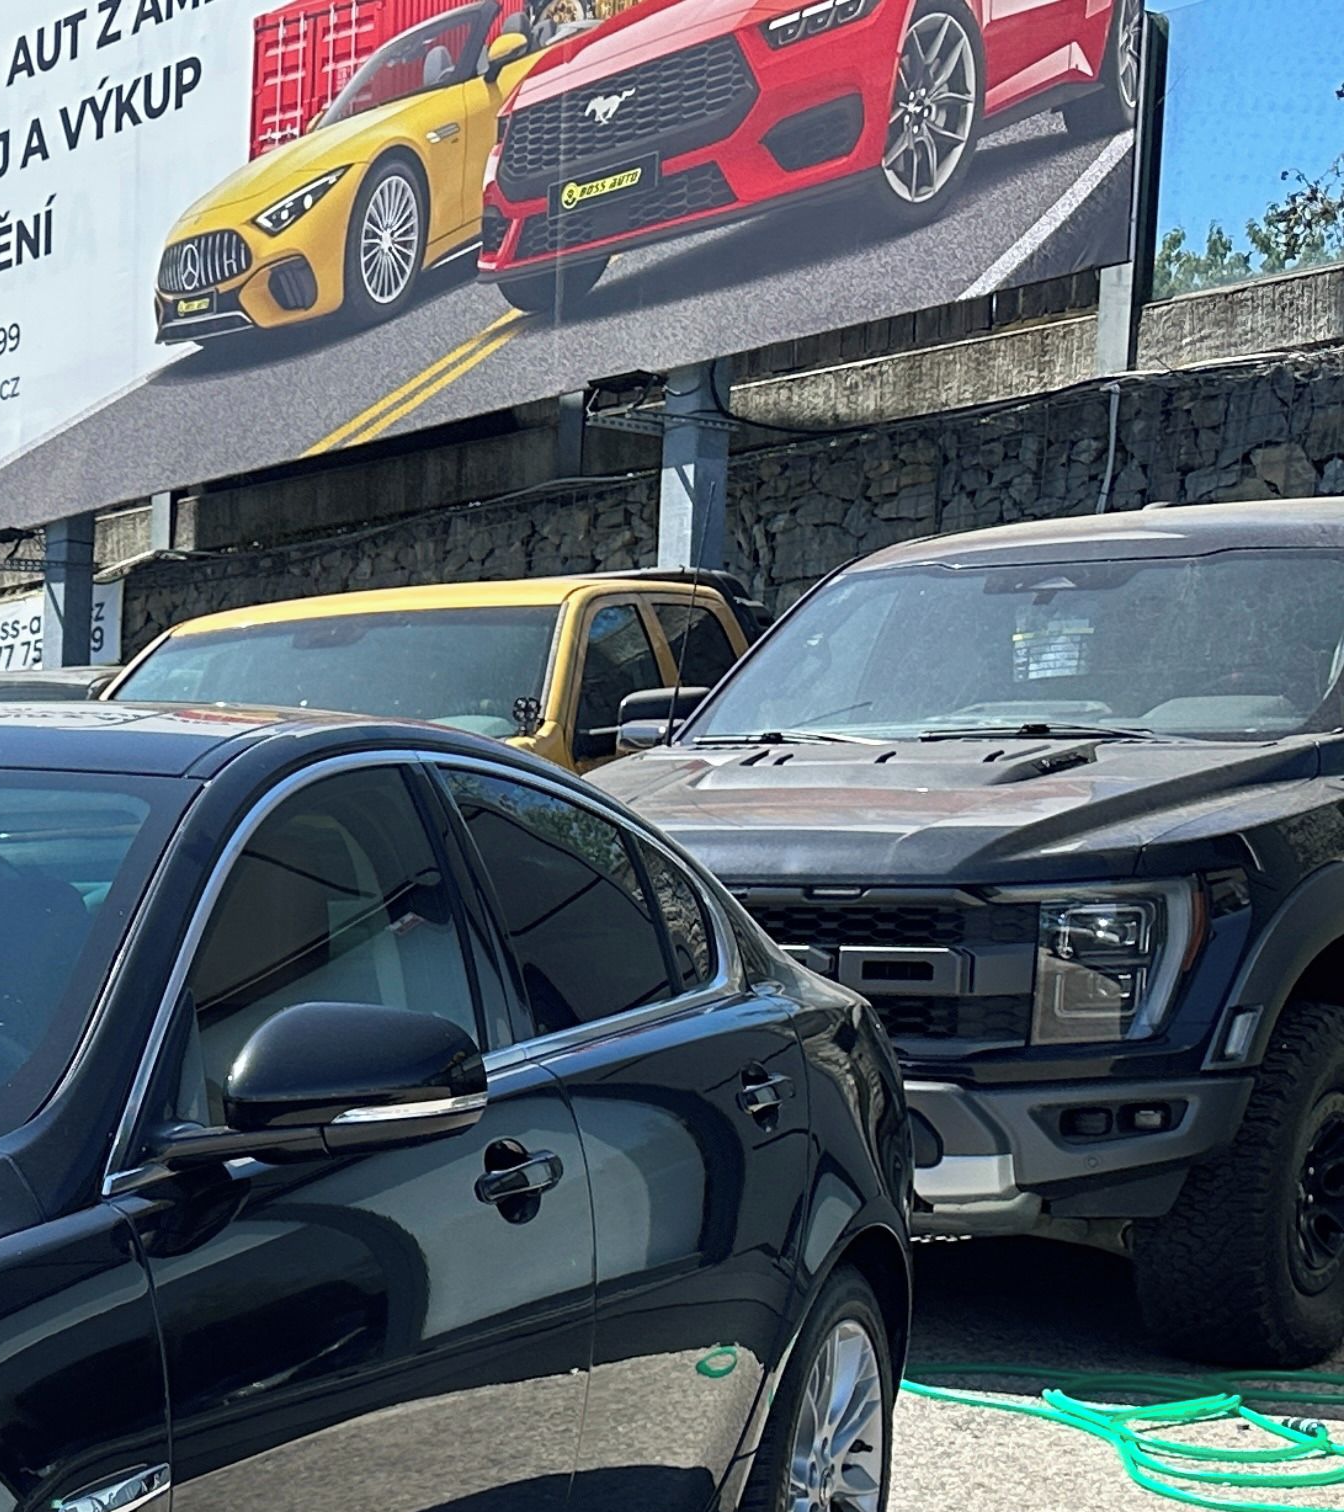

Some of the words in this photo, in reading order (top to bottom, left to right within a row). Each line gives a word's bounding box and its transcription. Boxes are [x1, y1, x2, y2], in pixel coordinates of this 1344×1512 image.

[6, 8, 88, 88] AUT
[96, 0, 122, 50] Z
[20, 117, 50, 169] A
[59, 56, 202, 150] VÝKUP
